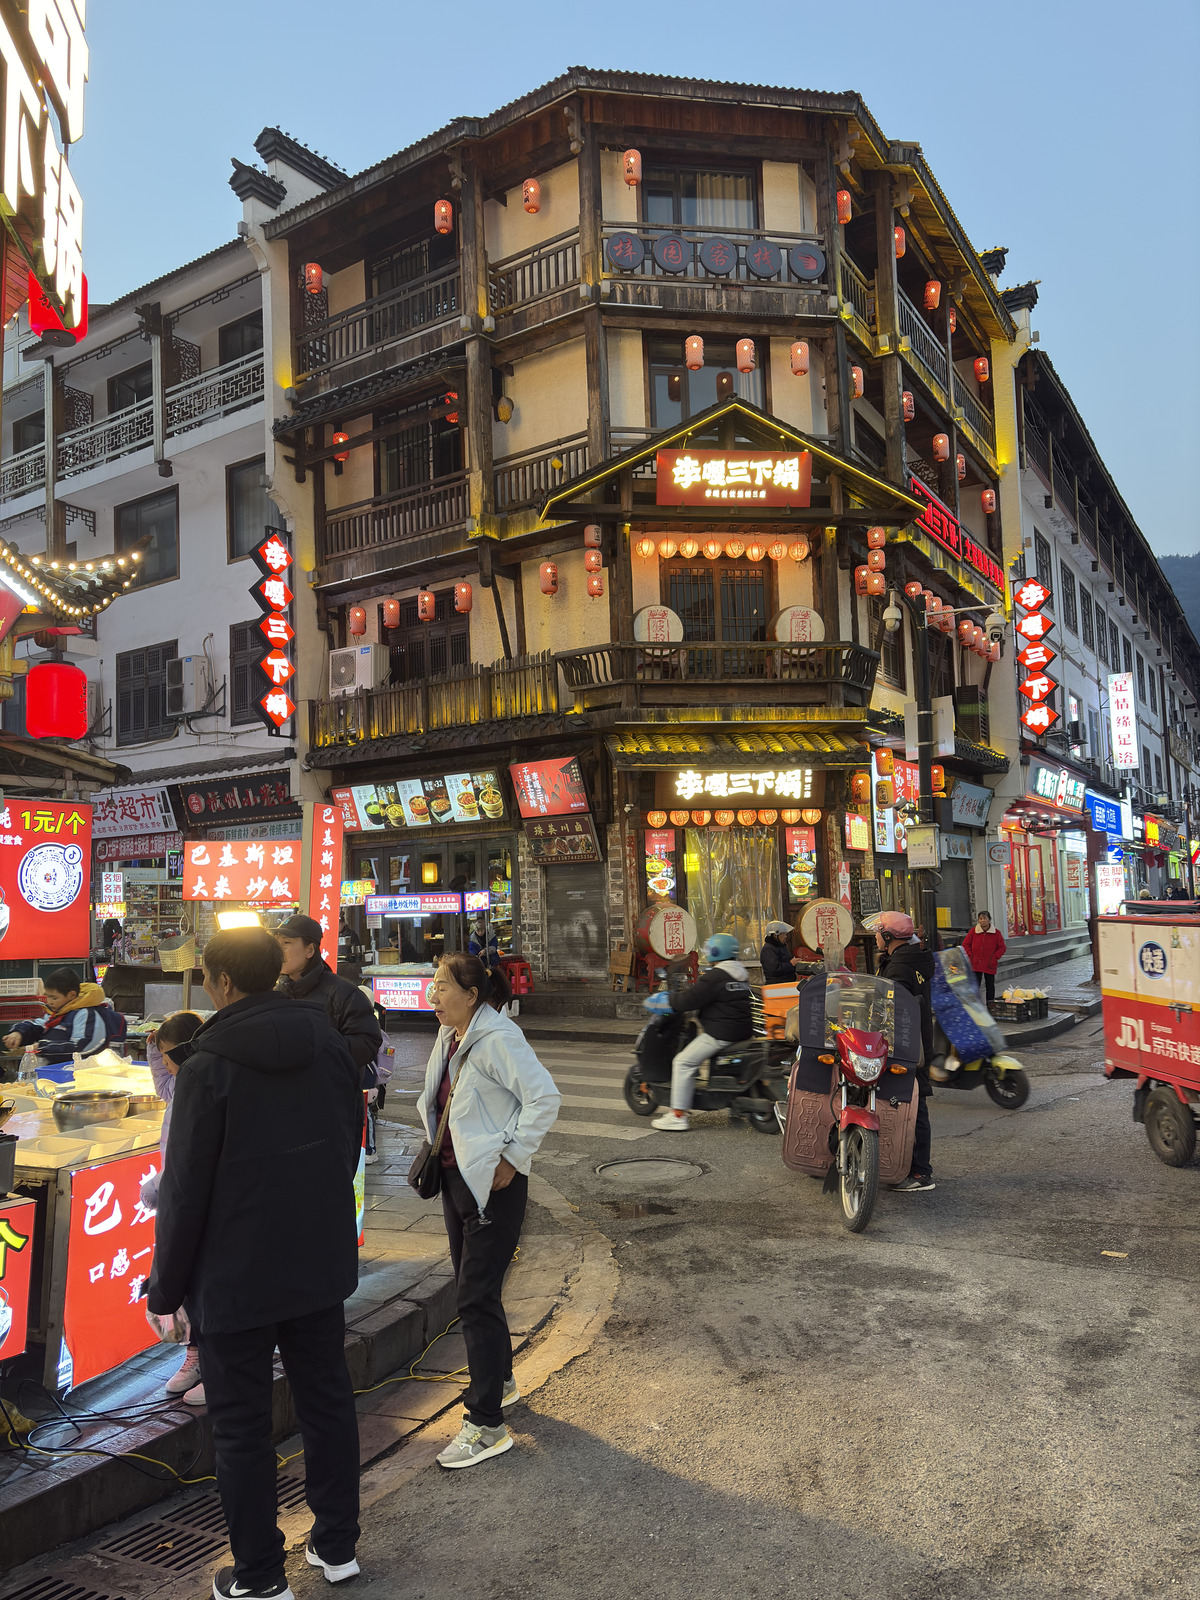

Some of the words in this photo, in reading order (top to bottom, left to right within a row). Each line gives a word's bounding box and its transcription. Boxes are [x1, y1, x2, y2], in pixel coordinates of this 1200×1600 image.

[21, 810, 86, 835] 1元/个
[191, 843, 294, 870] 巴基斯坦
[1142, 948, 1165, 973] 快递
[1115, 1016, 1152, 1053] JDL
[1152, 1036, 1200, 1066] 京东快递
